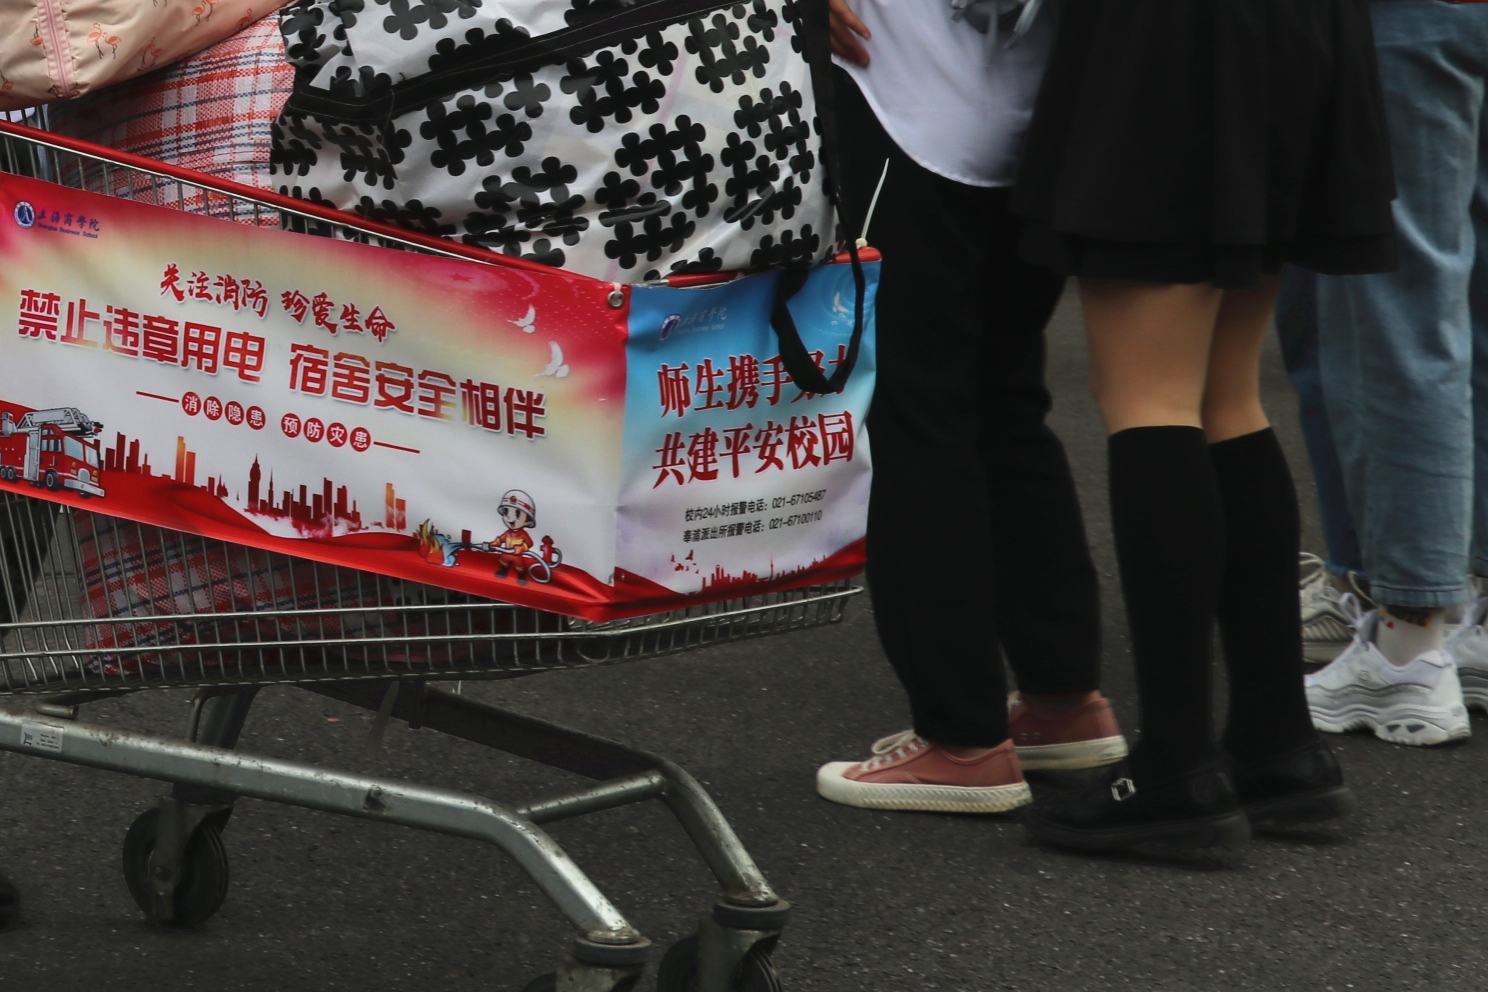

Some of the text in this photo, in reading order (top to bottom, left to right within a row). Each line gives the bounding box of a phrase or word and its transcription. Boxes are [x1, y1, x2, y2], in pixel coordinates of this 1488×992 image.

[160, 263, 396, 342] 关注消防 珍爱生命
[18, 289, 546, 439] 禁止违章用电 宿舍安全相伴
[183, 394, 370, 450] 消除隐患 预防灾患
[652, 410, 855, 489] 共建平安校园
[769, 510, 823, 530] 021-67100110
[771, 489, 826, 509] 021-67105487
